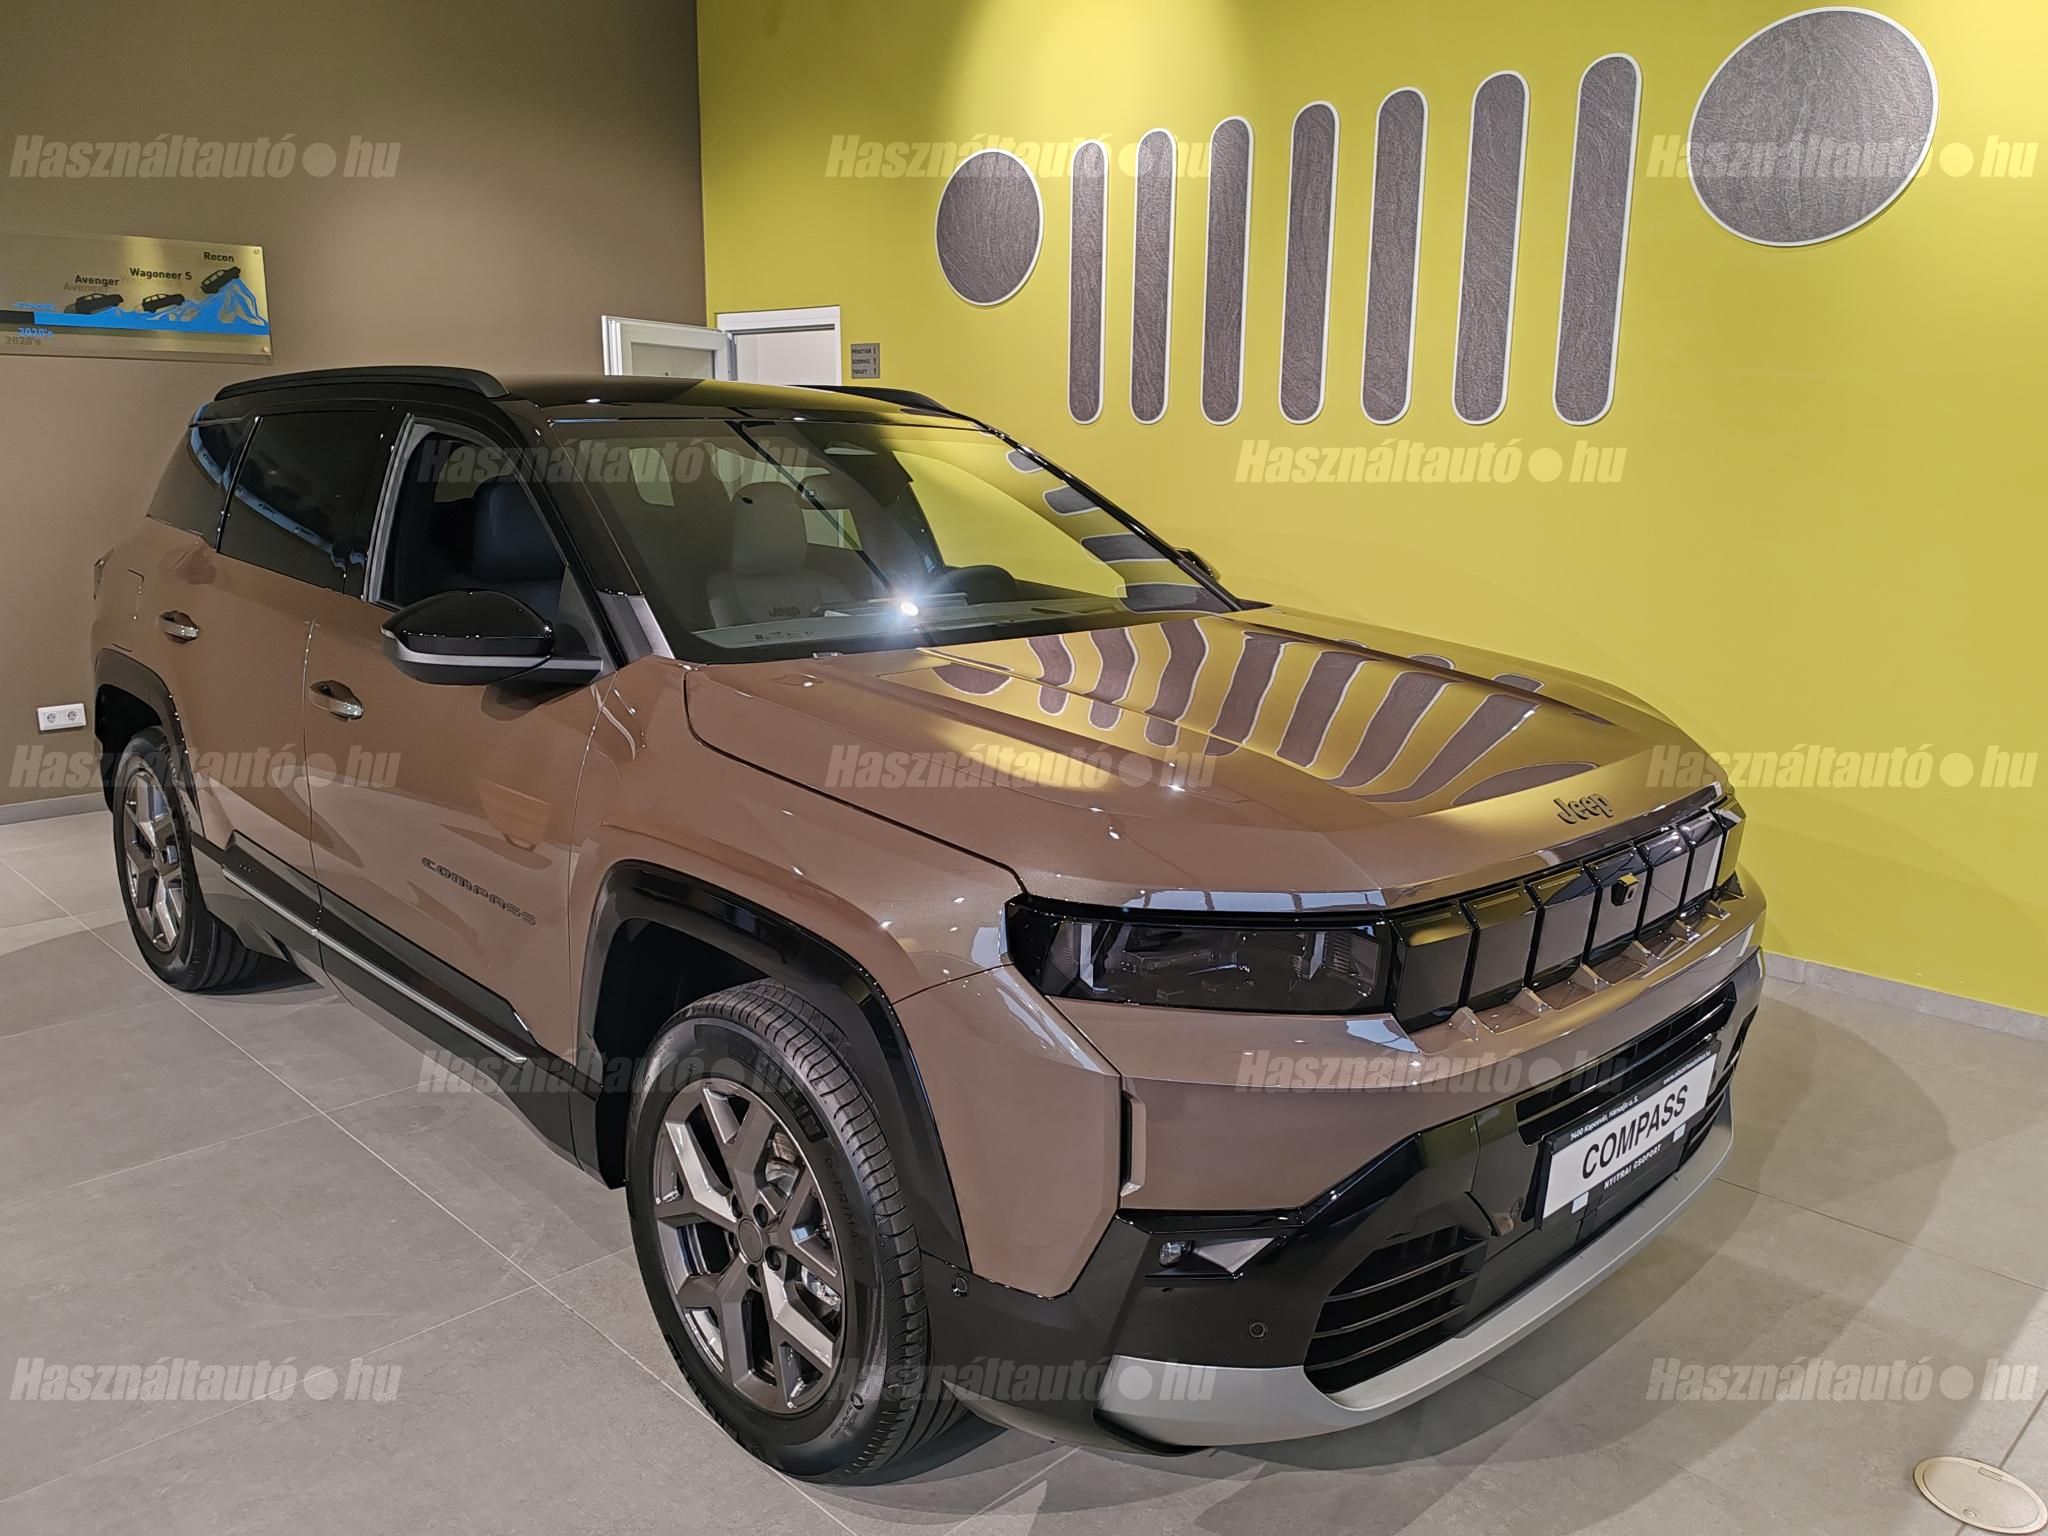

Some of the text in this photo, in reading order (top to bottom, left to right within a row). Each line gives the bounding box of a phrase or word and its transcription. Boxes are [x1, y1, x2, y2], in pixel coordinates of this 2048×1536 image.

[204, 251, 235, 263] Recon
[75, 274, 120, 288] Avenger
[129, 267, 193, 281] Wagoneer S
[1553, 793, 1615, 825] Jeep
[421, 857, 536, 926] COMPASS
[1582, 1084, 1688, 1179] COMPASS
[1603, 1143, 1662, 1190] NYITRAI CSOPORT
